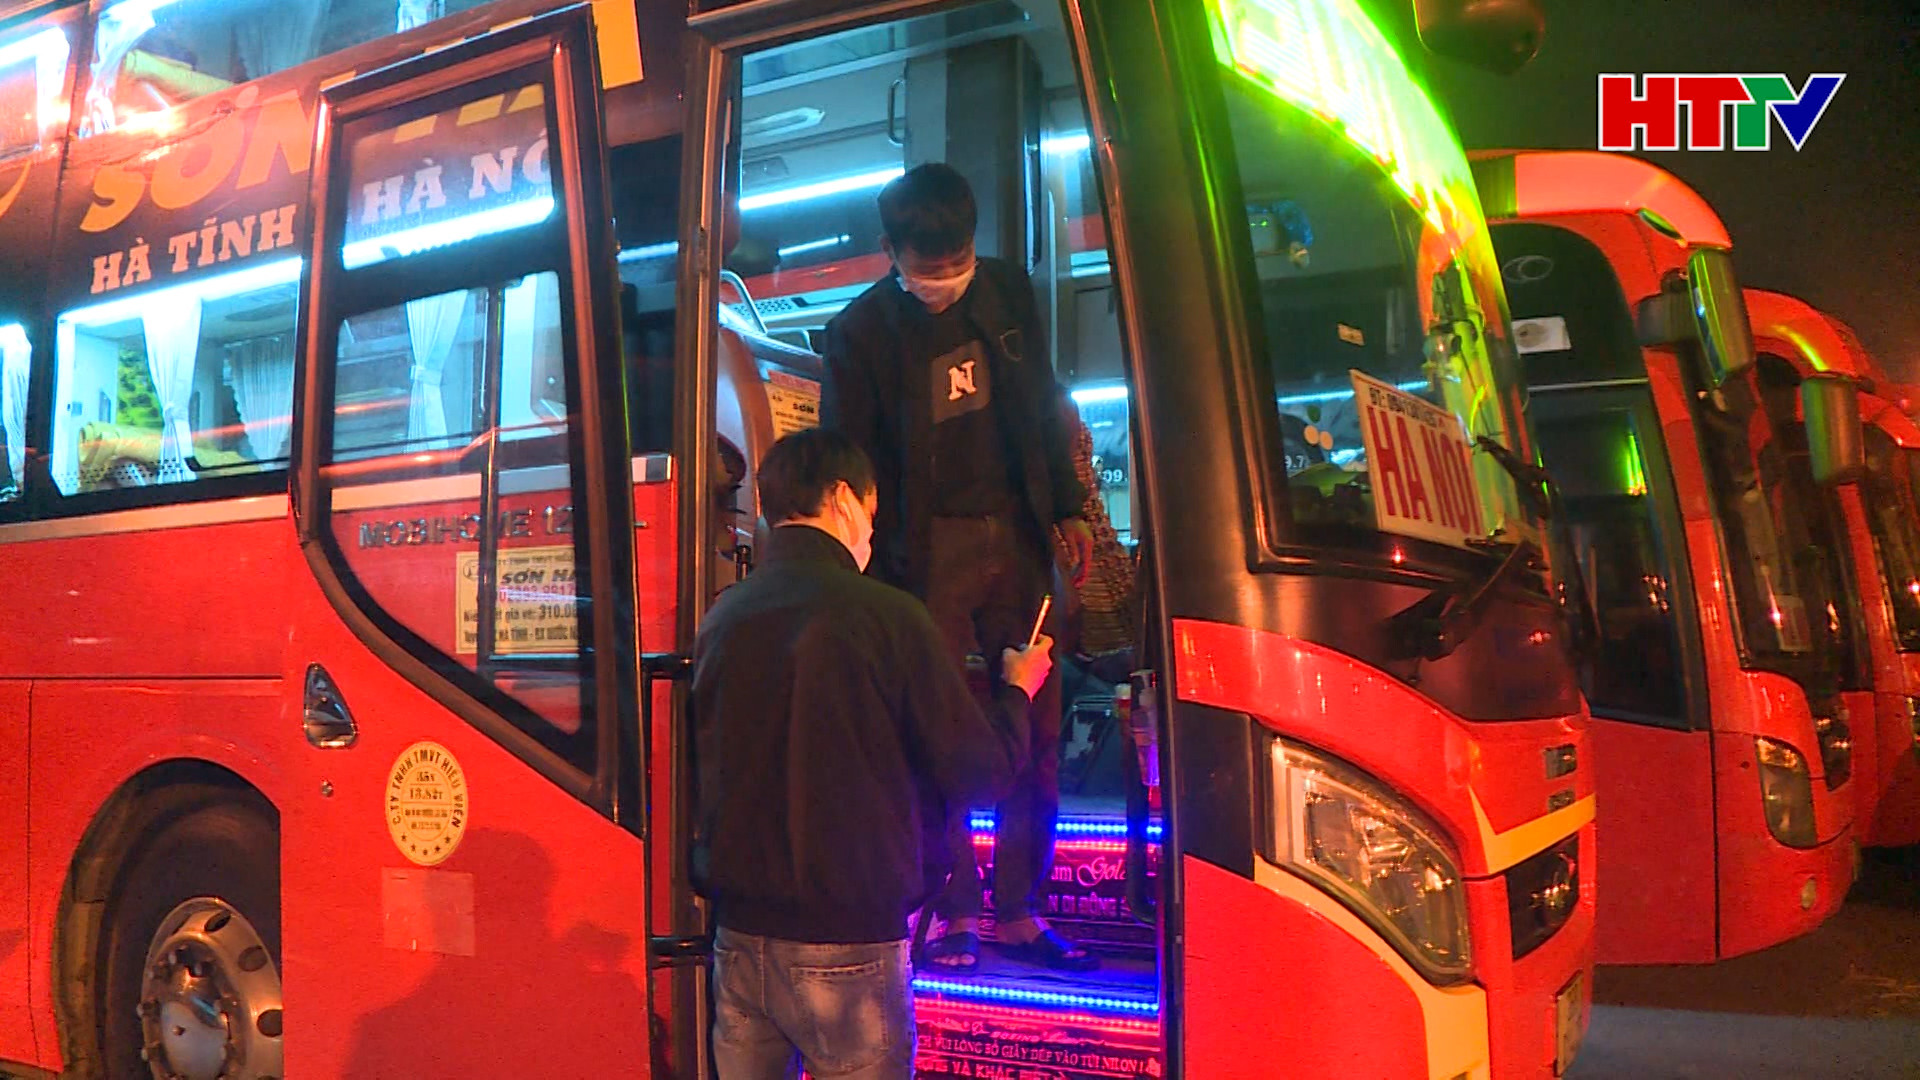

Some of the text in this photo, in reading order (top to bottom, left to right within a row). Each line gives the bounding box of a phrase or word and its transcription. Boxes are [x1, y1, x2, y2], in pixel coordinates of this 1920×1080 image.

[91, 237, 151, 294] HÀ
[168, 204, 297, 273] TĨNH
[360, 157, 447, 225] HÀ
[947, 360, 977, 401] N
